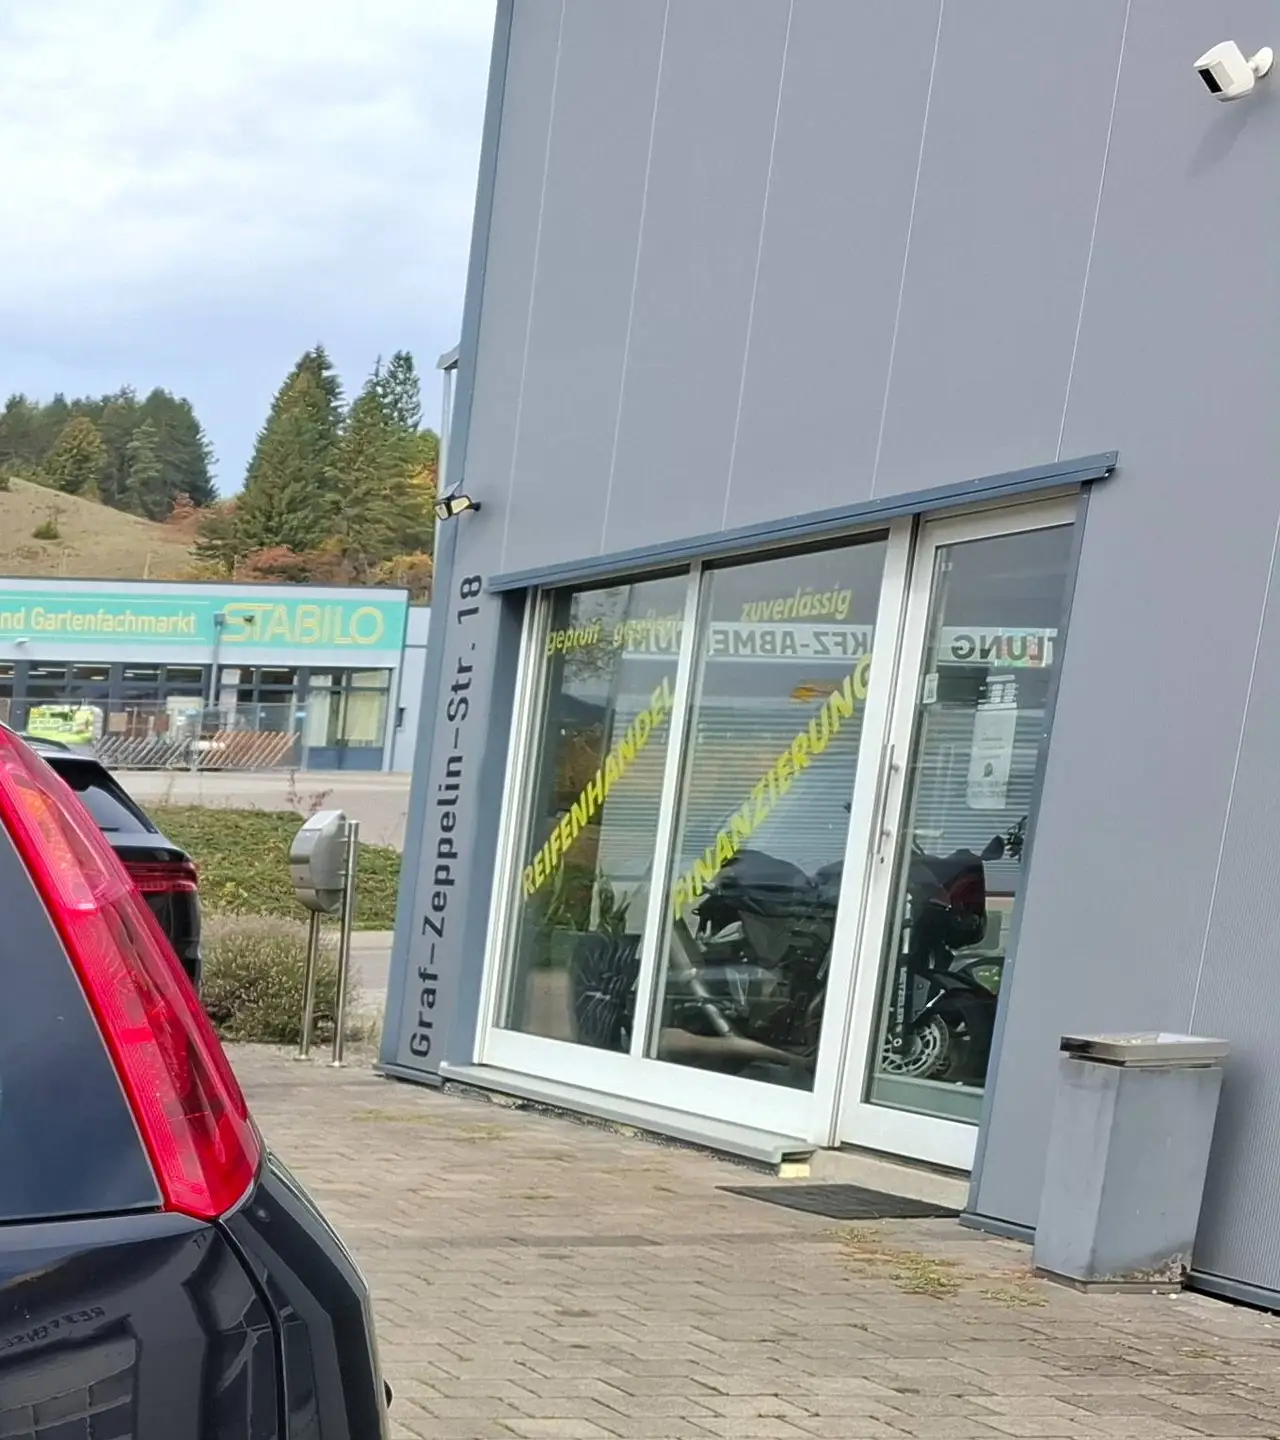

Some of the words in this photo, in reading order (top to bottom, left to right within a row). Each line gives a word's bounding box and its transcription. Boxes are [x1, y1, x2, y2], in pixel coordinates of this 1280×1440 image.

[31, 606, 197, 634] Gartenfachmarkt
[457, 574, 483, 625] 18
[222, 602, 385, 645] STABILO
[522, 676, 675, 898] REIFENHANDEL
